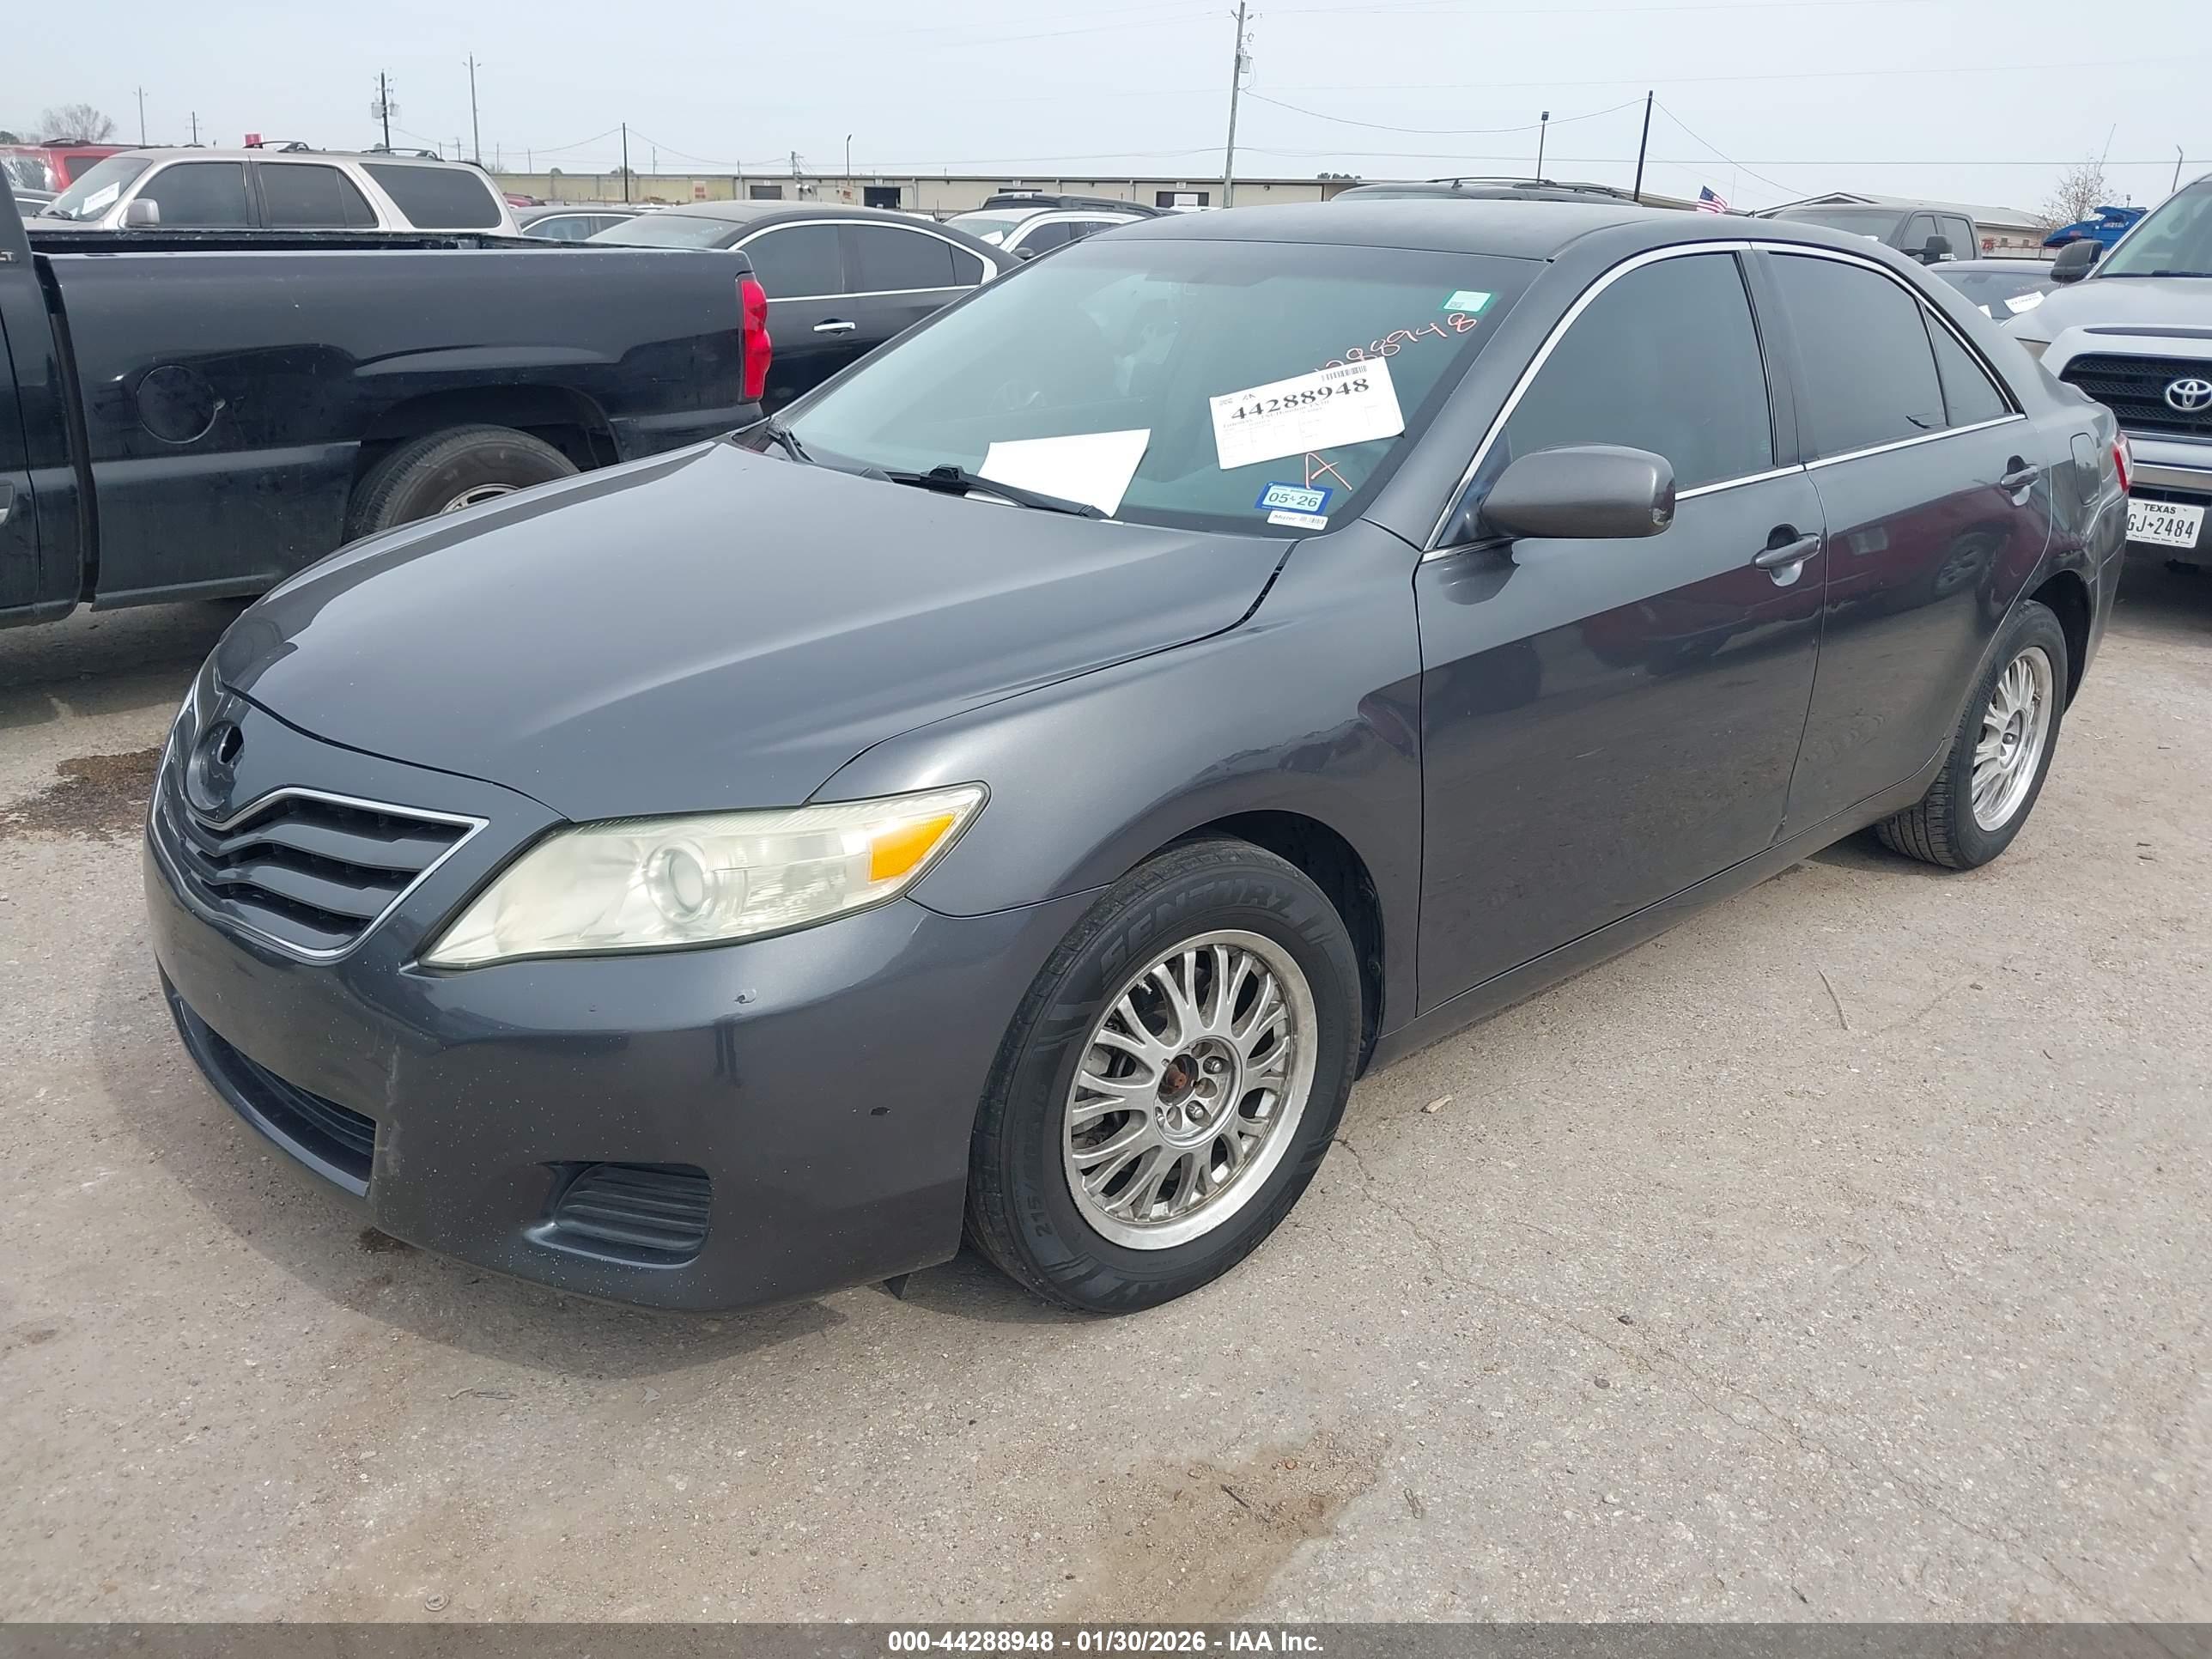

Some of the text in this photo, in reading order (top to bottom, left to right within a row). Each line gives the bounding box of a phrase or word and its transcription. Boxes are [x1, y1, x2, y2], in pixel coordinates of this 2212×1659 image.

[1231, 378, 1370, 420] 44288948
[1304, 453, 1353, 490] A
[2144, 503, 2177, 514] TEXAS
